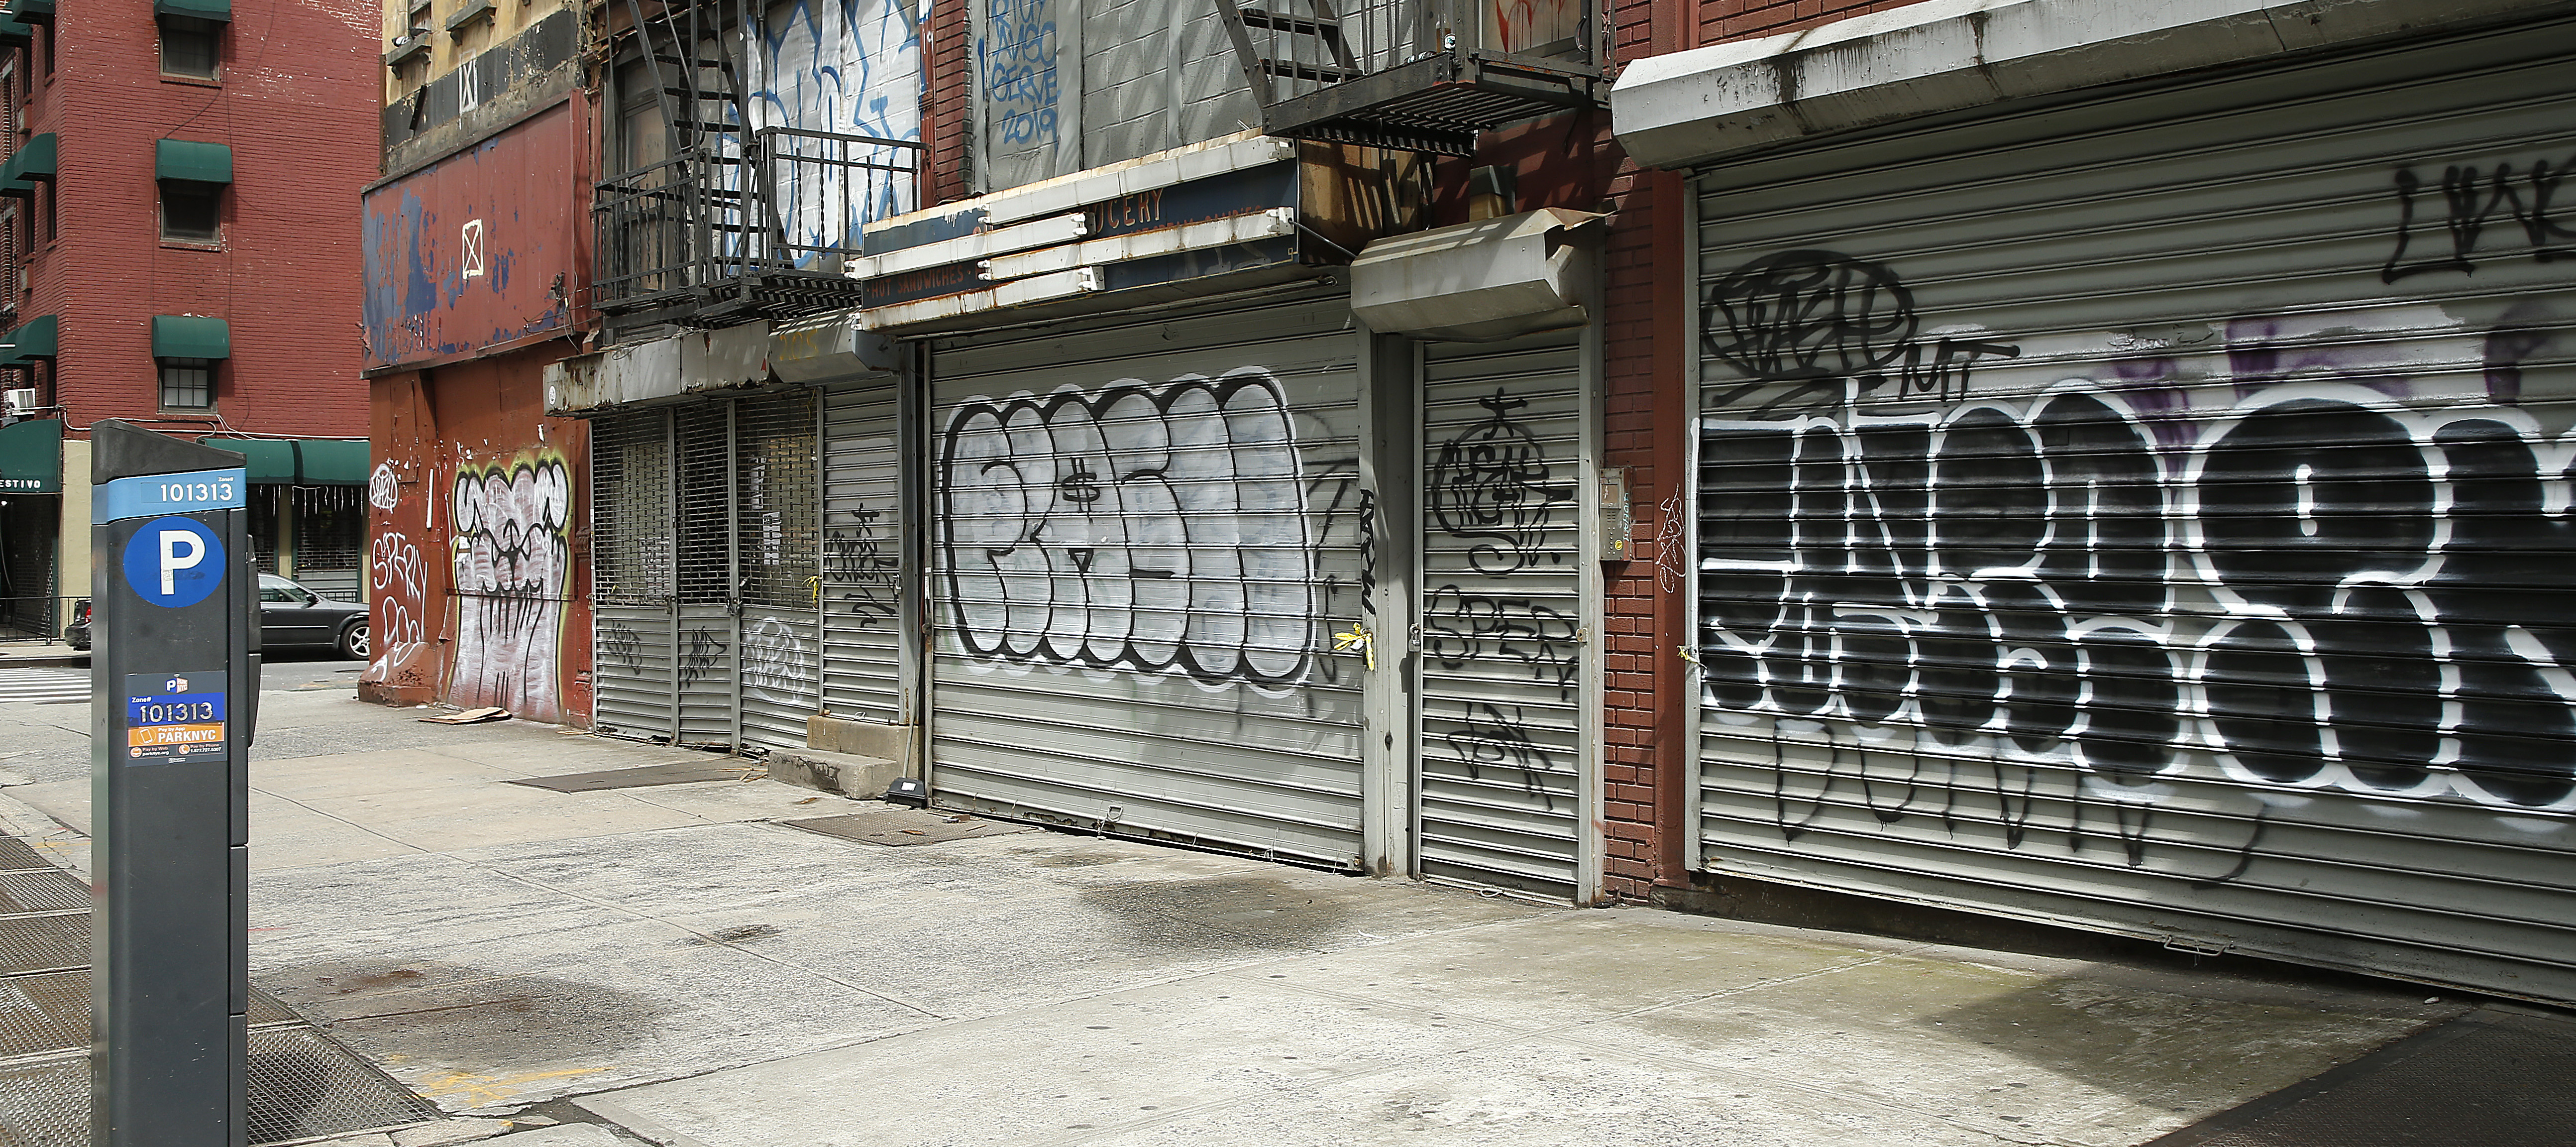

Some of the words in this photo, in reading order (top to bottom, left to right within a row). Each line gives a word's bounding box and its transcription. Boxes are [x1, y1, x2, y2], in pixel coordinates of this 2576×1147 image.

[1001, 104, 1058, 155] 2019
[871, 278, 891, 299] HOT
[898, 264, 965, 294] SANDWICHES
[160, 483, 233, 502] 101313
[159, 530, 206, 595] P
[140, 702, 213, 723] 101313
[158, 729, 216, 743] PARKNYC
